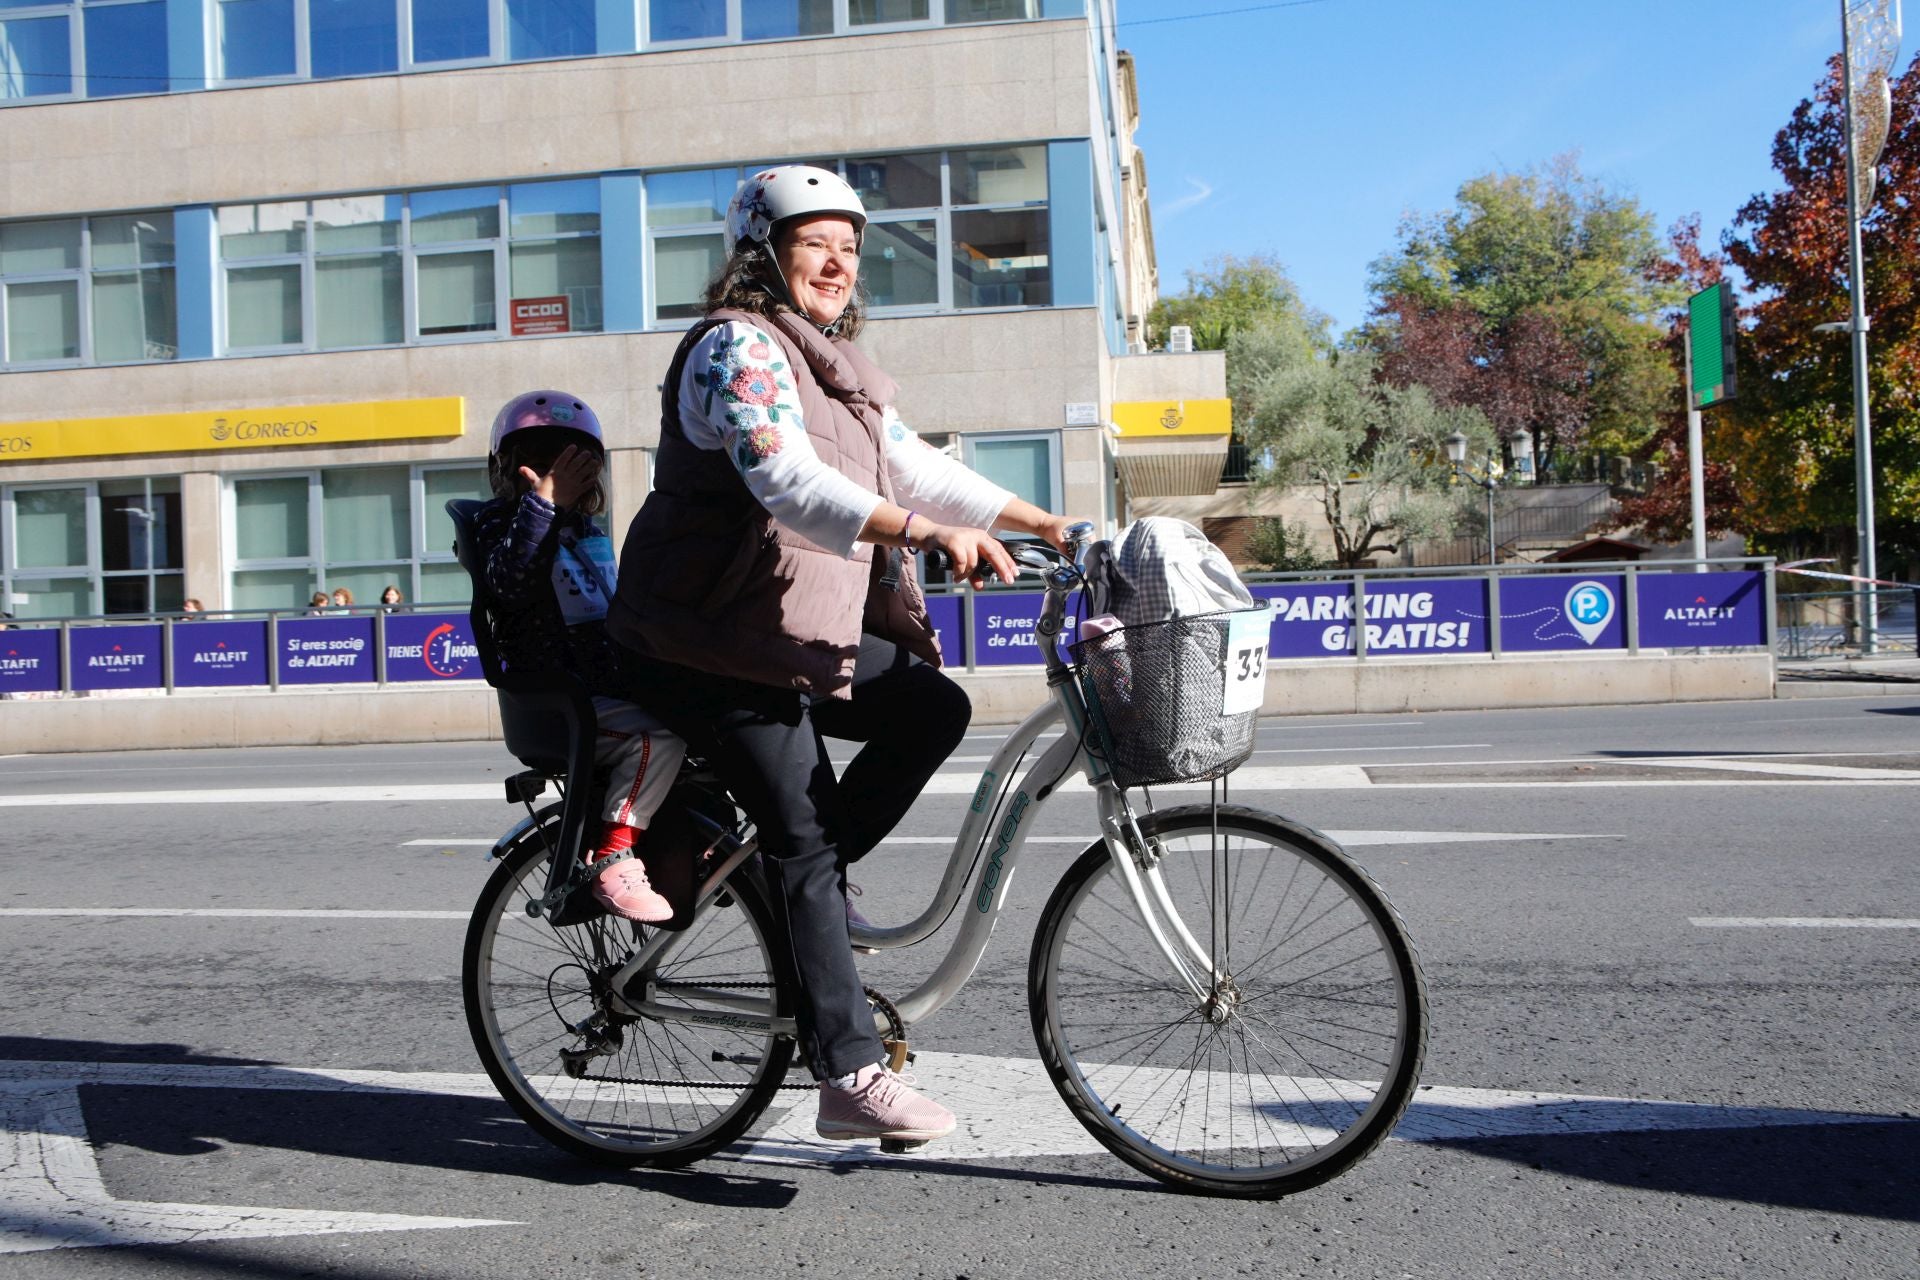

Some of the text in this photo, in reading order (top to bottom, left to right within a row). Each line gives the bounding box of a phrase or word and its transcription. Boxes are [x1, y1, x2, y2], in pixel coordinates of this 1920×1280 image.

[517, 303, 563, 318] CCOO
[1664, 606, 1736, 621] ALTAFIT
[987, 615, 1001, 629] Si
[1004, 618, 1034, 628] eres
[288, 639, 301, 651] Si
[302, 641, 328, 651] eres
[988, 632, 1070, 647] de ALTT
[194, 651, 249, 664] ALTAFIT
[388, 645, 423, 659] TIENES
[442, 640, 452, 663] 1
[88, 654, 145, 667] ALTAFIT
[288, 654, 358, 668] de ALTAFIT
[1237, 644, 1268, 681] 33
[977, 790, 1029, 913] CONOR
